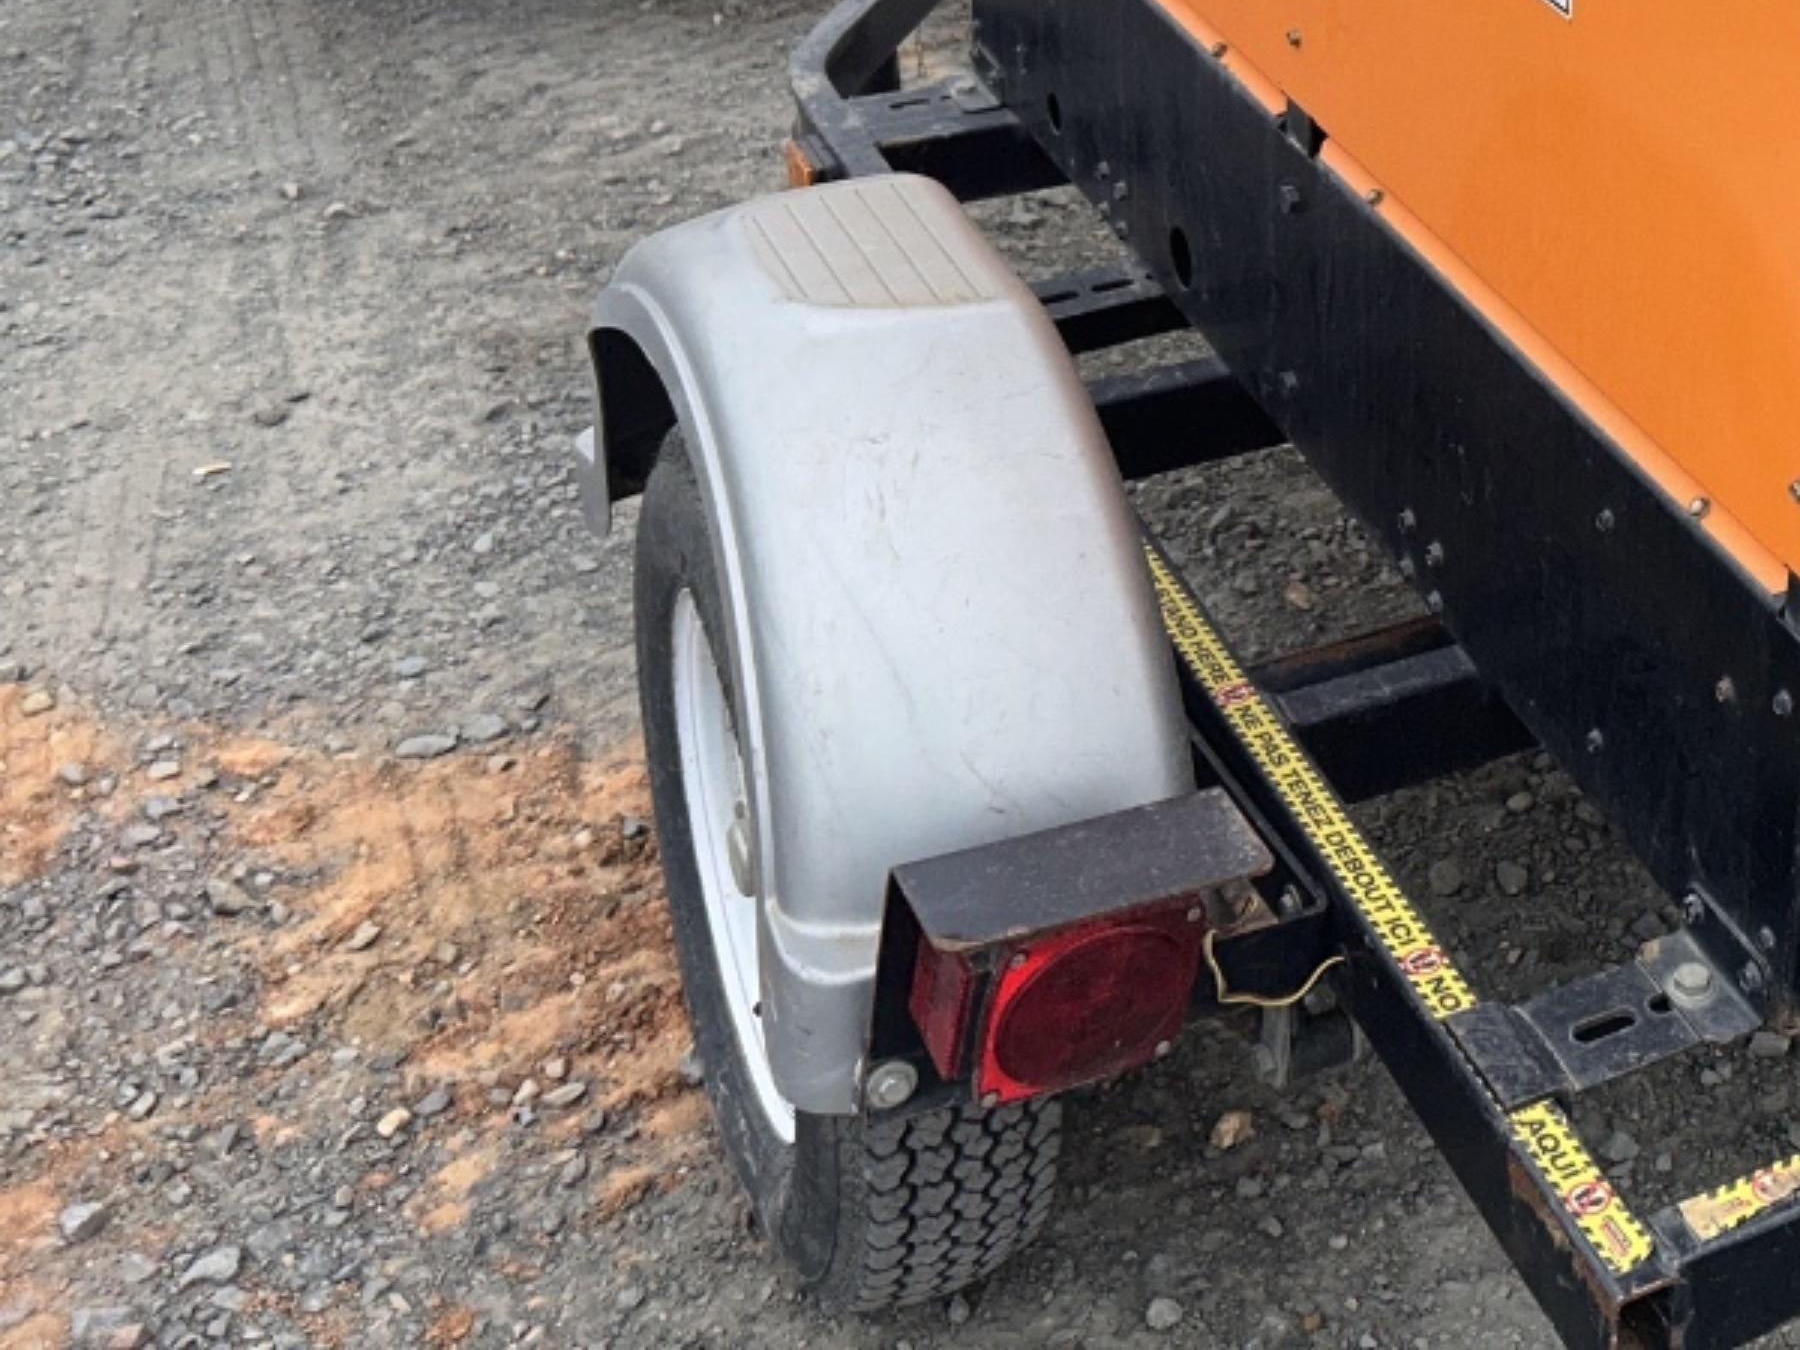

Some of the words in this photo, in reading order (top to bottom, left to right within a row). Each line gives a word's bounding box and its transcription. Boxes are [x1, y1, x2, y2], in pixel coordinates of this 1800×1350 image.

[1252, 731, 1293, 768] PAS
[1279, 768, 1336, 830] TENEZ
[1325, 829, 1397, 918] DEBOUT
[1385, 916, 1417, 947] ICI
[1425, 974, 1462, 1011] NO
